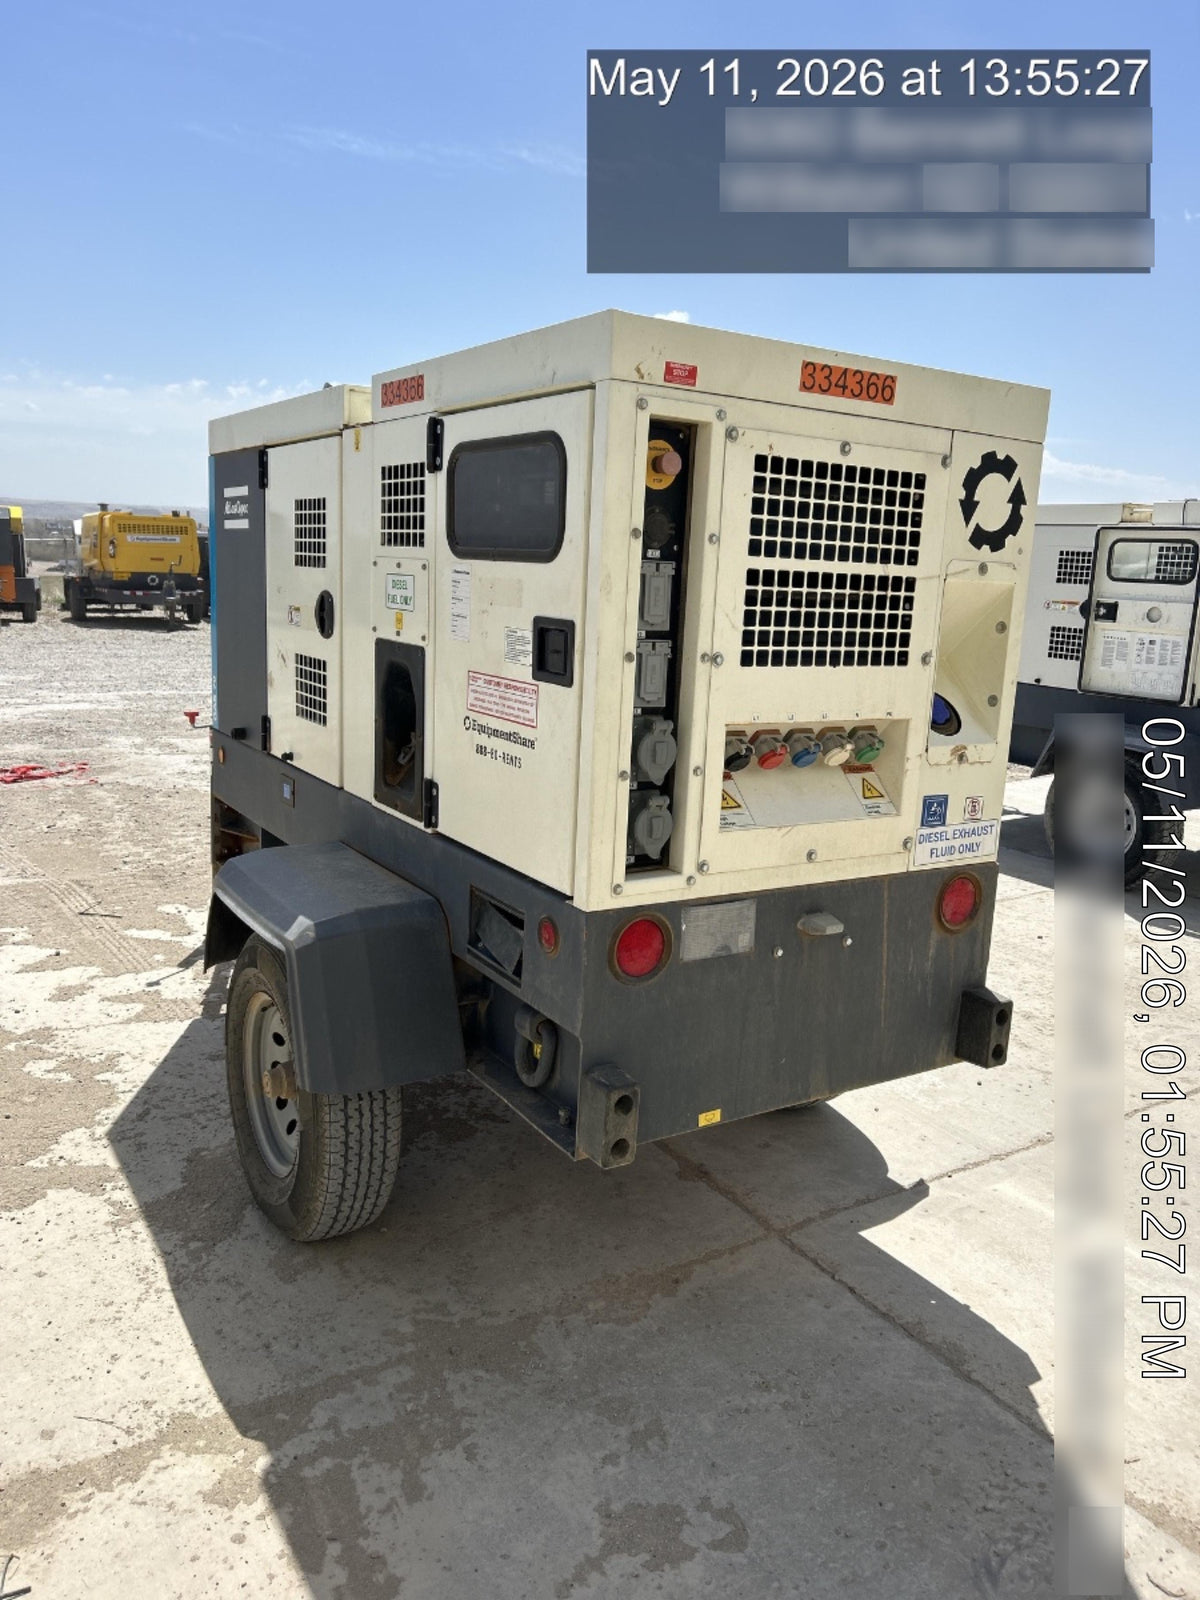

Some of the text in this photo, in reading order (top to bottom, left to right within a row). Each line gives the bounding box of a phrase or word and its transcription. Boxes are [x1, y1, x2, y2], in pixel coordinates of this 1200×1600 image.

[381, 374, 424, 407] 334366
[802, 361, 896, 402] 334366
[471, 718, 536, 750] EquipmentShare
[918, 824, 995, 845] DIESEL EXHAUST
[930, 841, 982, 859] FLUID ONLY
